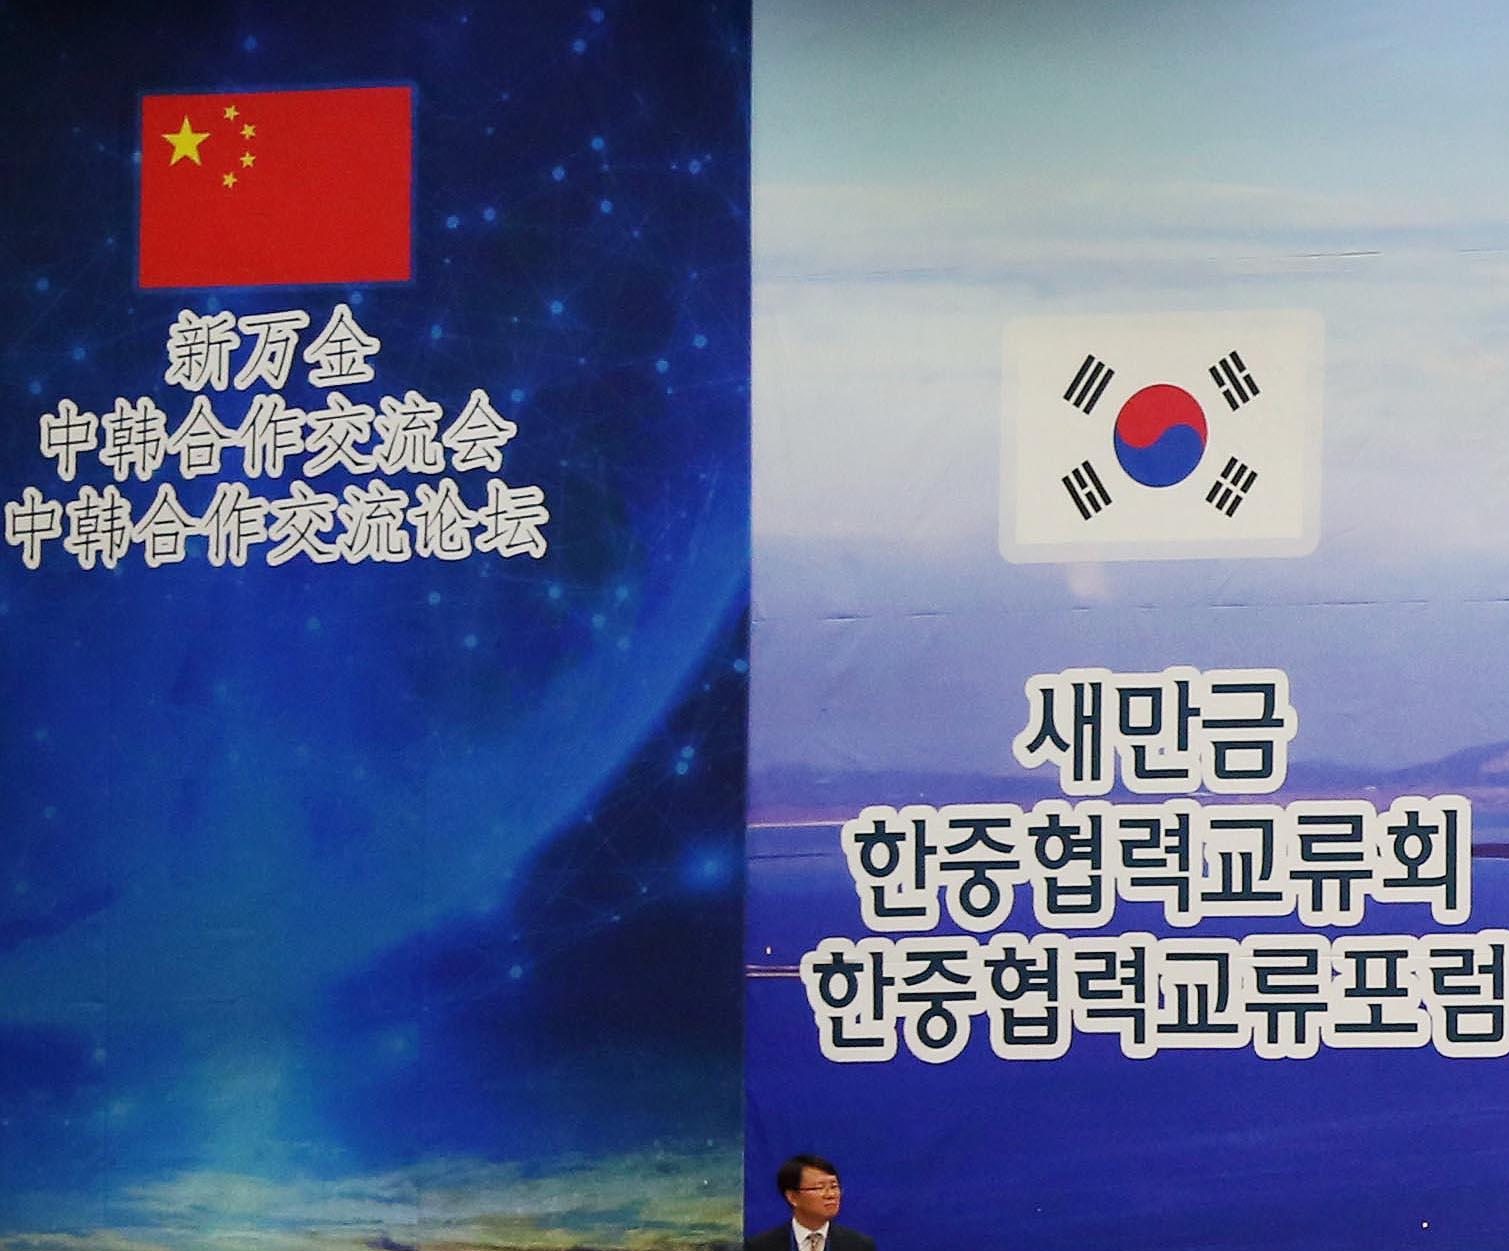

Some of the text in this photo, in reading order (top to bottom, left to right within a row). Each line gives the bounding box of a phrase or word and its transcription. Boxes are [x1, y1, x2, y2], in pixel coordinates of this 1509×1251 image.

[167, 305, 380, 391] 新万金
[40, 389, 517, 481] 中韩合作交流会
[4, 480, 551, 569] 中韩合作交流论坛
[1022, 675, 1289, 784] 새만금
[850, 804, 1463, 922] 한중협력교류회
[808, 940, 1509, 1053] 한중협력교류포럼
